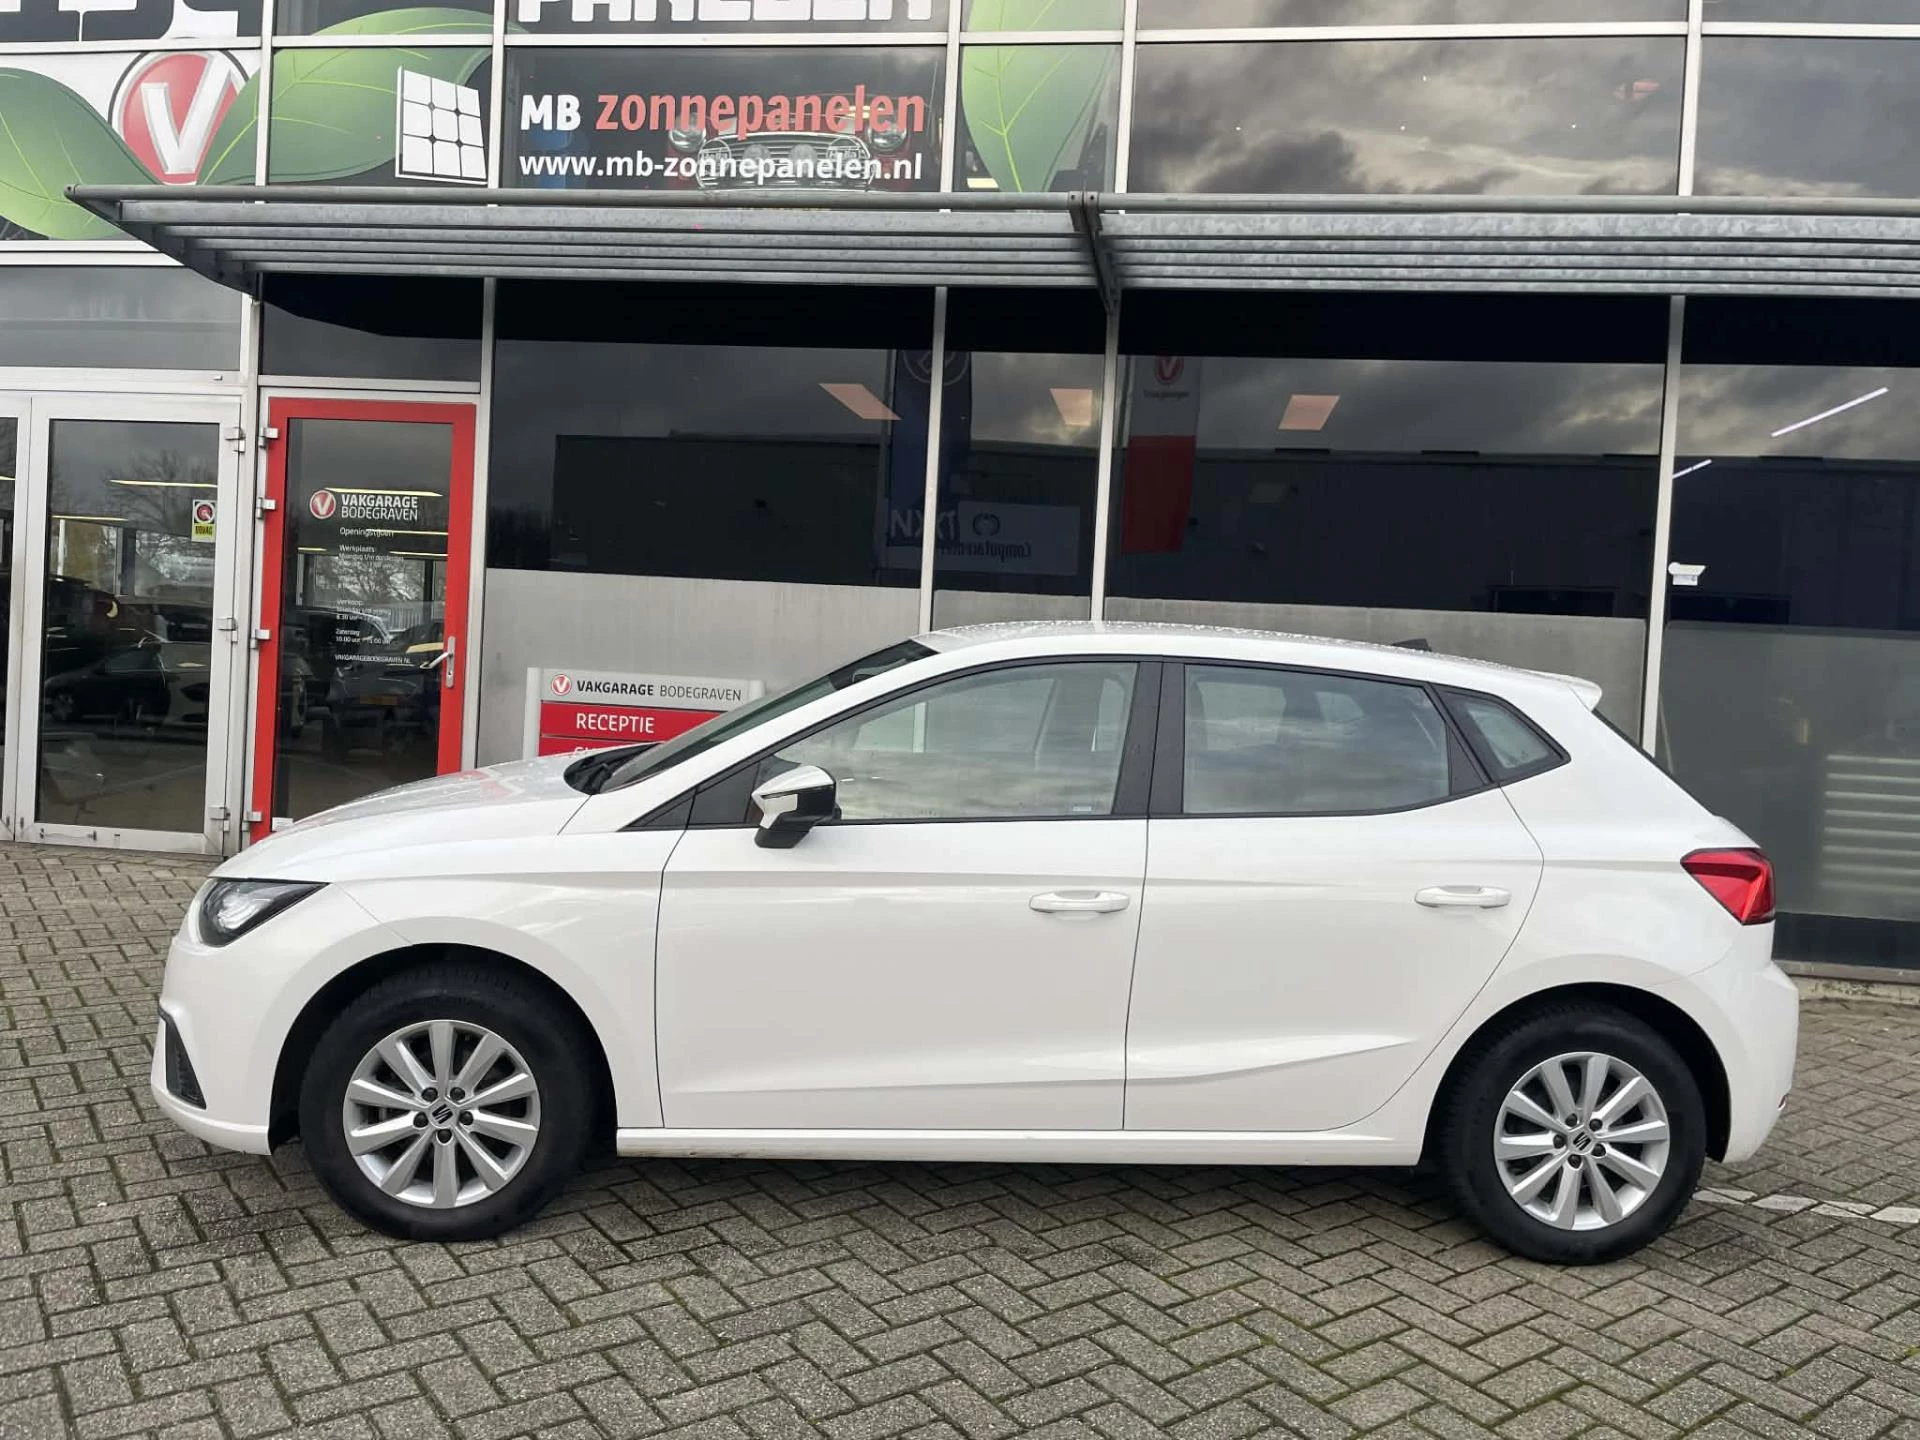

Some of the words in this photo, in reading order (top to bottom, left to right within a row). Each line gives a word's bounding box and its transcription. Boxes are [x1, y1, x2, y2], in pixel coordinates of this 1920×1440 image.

[520, 94, 581, 131] MB
[595, 84, 925, 141] zonnepanelen
[519, 150, 922, 186] www.mb-zonnepanelen.nl
[341, 494, 418, 508] VAKGARAGE
[341, 506, 418, 521] BODEGRAVEN
[577, 680, 654, 696] VAKGARAGE
[660, 684, 742, 702] BODEGRAVEN
[576, 713, 655, 734] RECEPTIE
